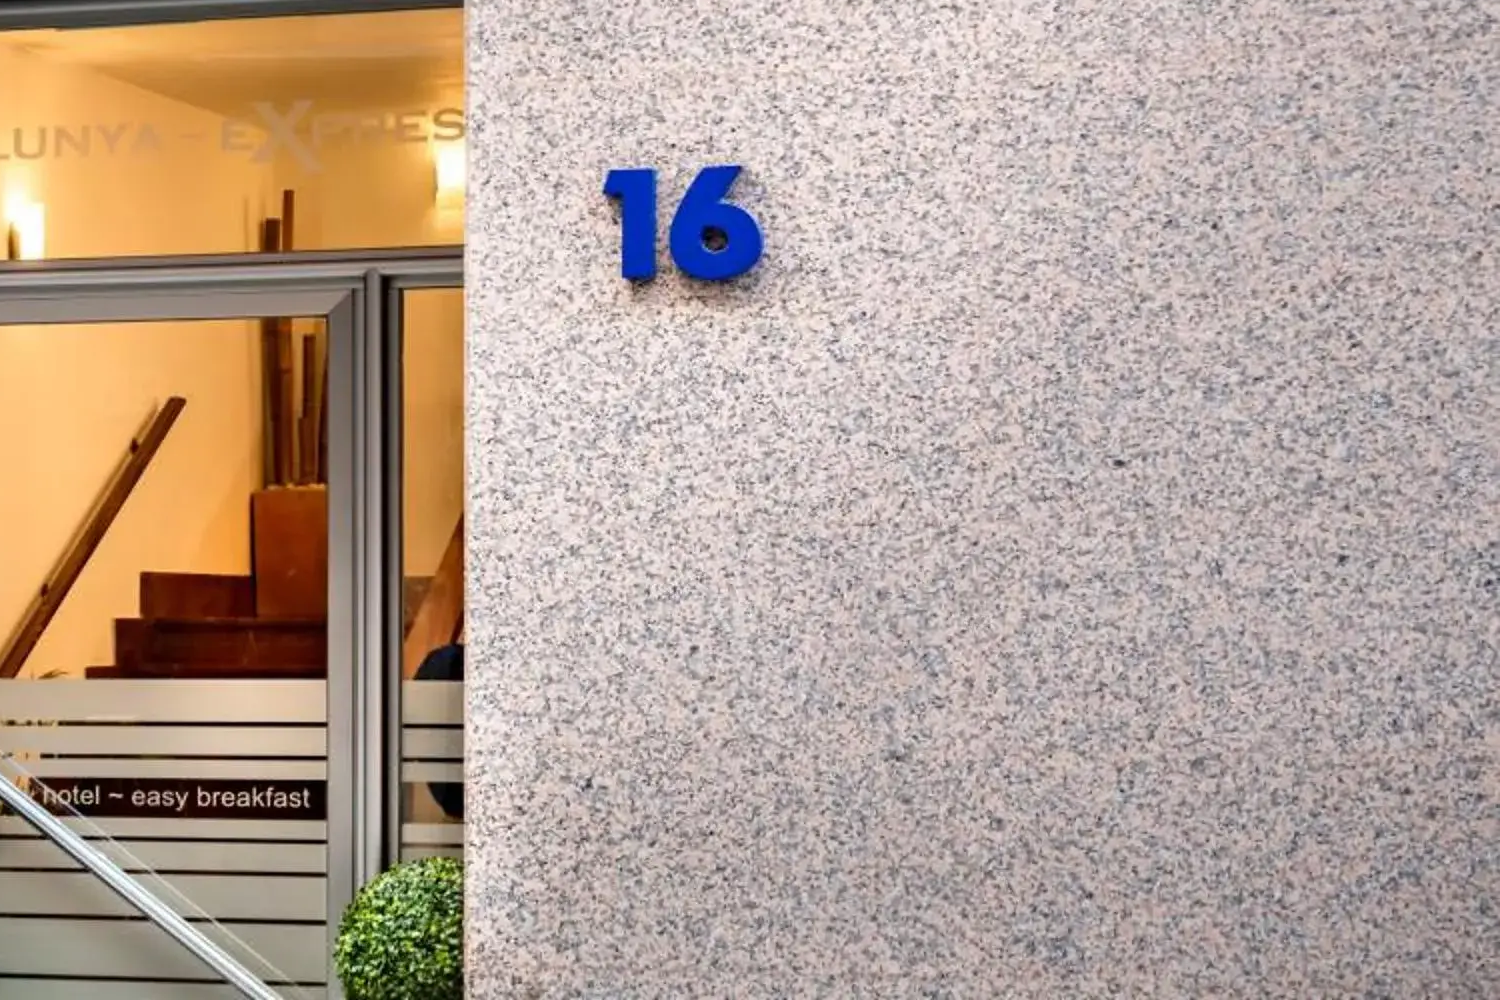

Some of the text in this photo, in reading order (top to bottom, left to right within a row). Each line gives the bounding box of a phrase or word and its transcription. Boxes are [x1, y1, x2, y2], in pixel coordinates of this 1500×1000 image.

[602, 163, 765, 281] 16
[42, 785, 101, 807] hotel
[131, 789, 189, 812] easy
[197, 786, 312, 809] breakfast
